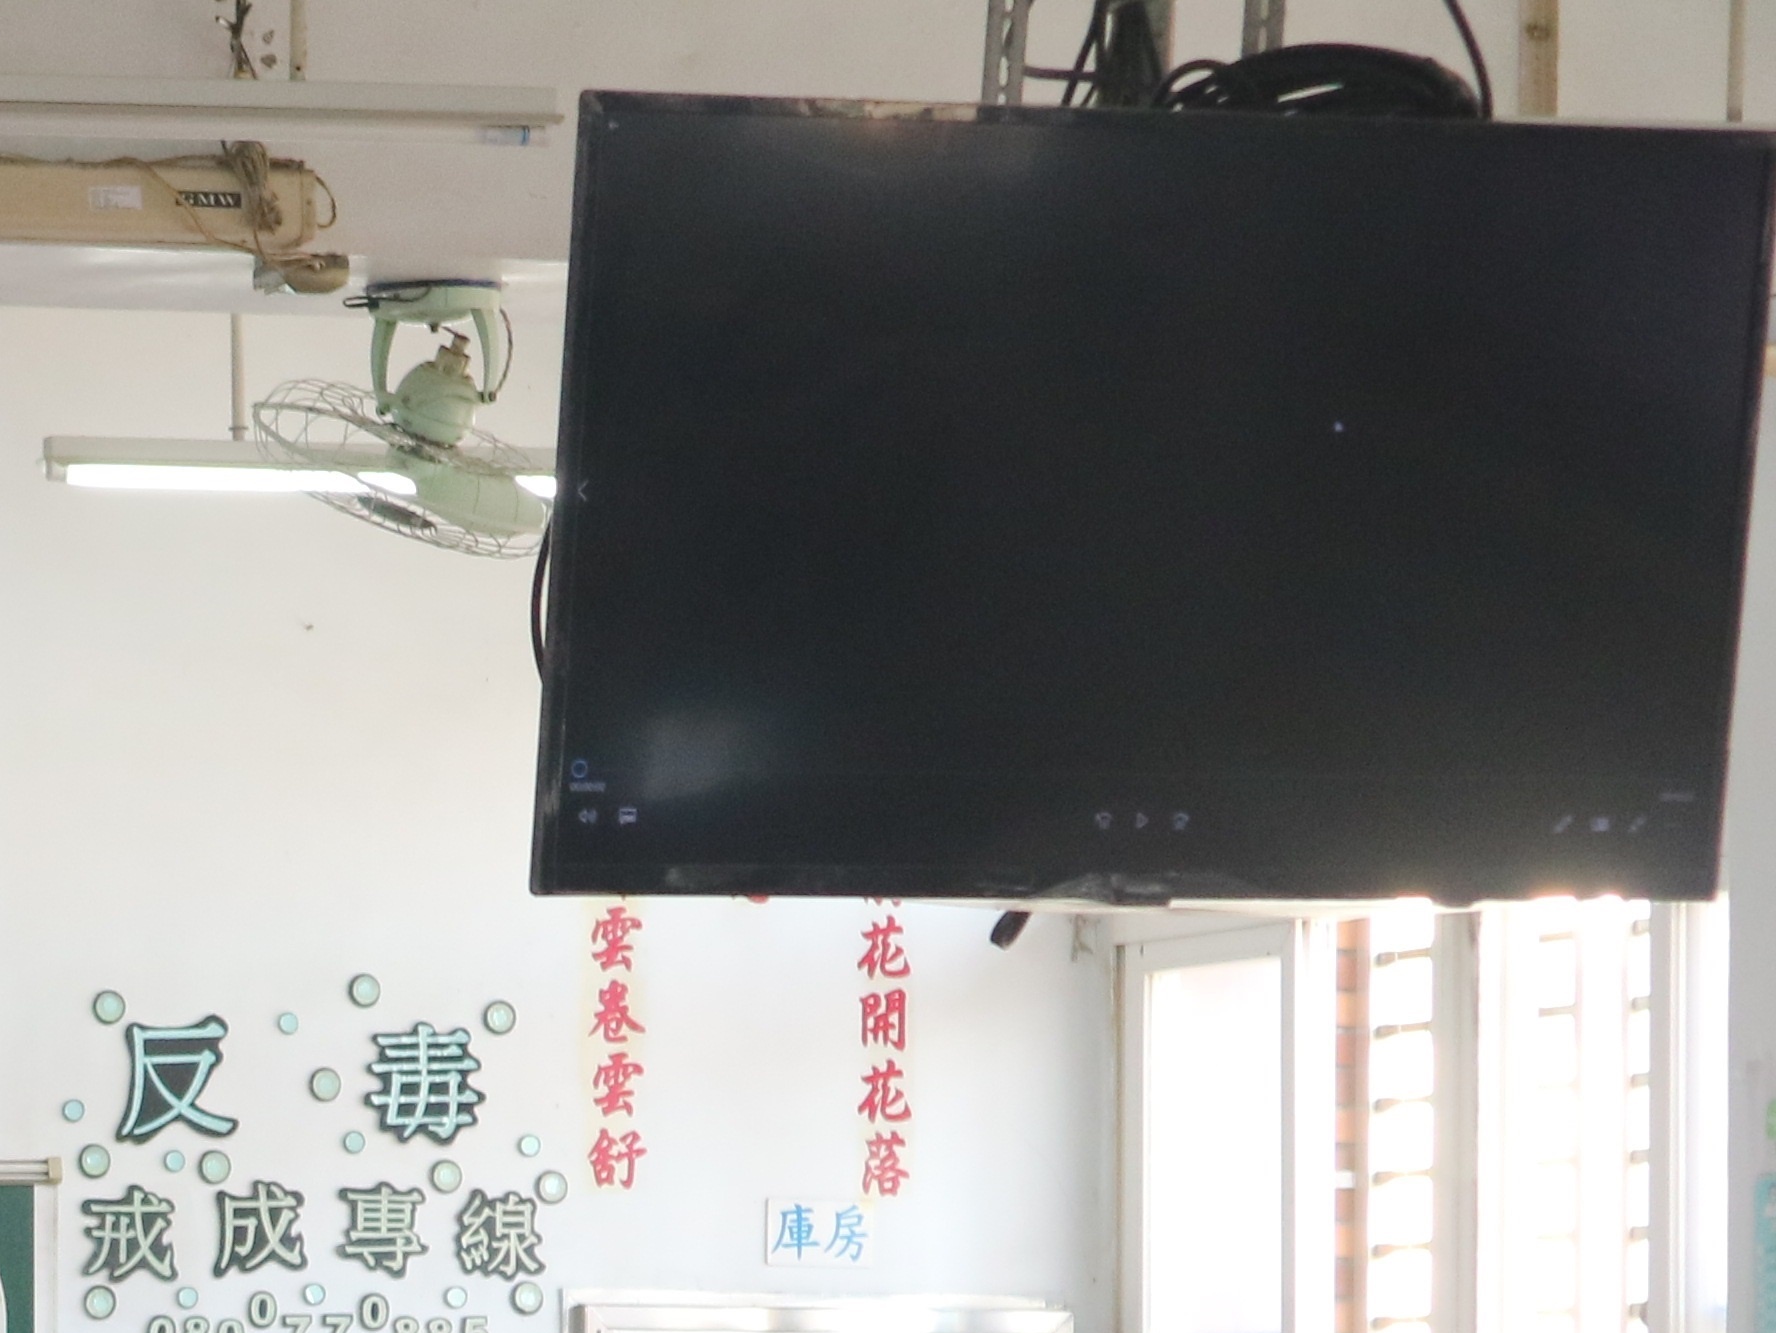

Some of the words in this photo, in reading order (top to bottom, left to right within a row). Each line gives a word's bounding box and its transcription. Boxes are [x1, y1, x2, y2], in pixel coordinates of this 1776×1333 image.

[116, 1014, 485, 1143] 反毒
[857, 897, 912, 1197] 花開花落
[82, 1180, 546, 1280] 戒成專線
[771, 1204, 868, 1262] 庫房
